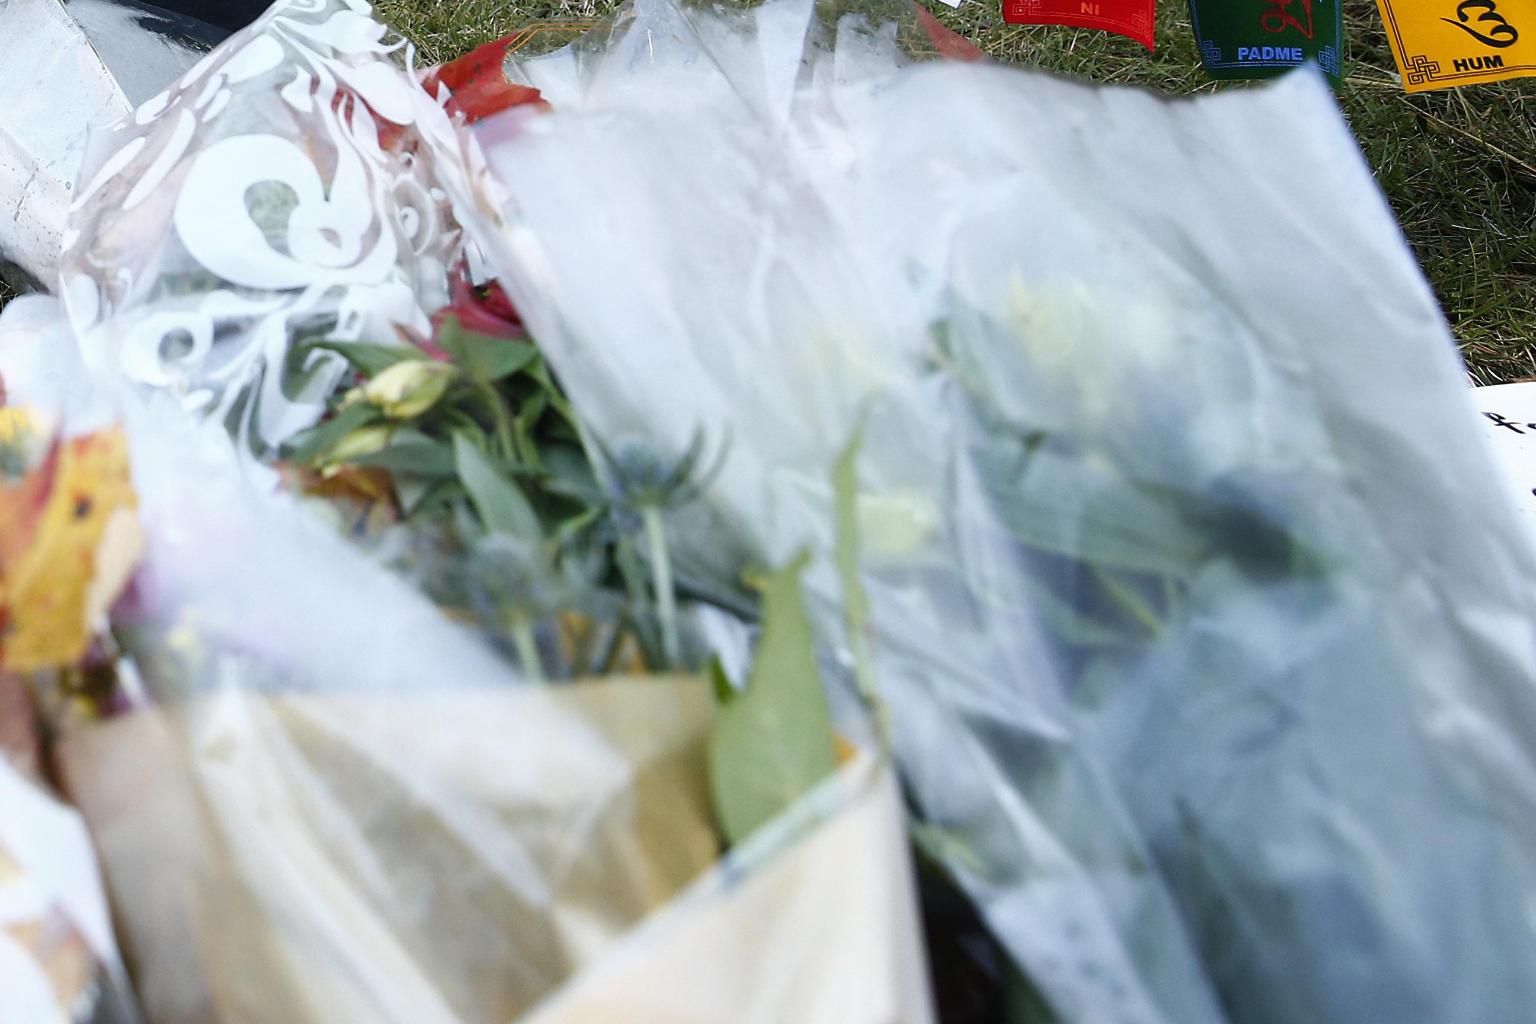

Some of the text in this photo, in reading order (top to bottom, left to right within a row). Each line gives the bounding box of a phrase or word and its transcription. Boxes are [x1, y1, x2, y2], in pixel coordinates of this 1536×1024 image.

[1080, 2, 1100, 16] NI
[1238, 46, 1303, 61] PADME
[1452, 55, 1504, 73] HUM
